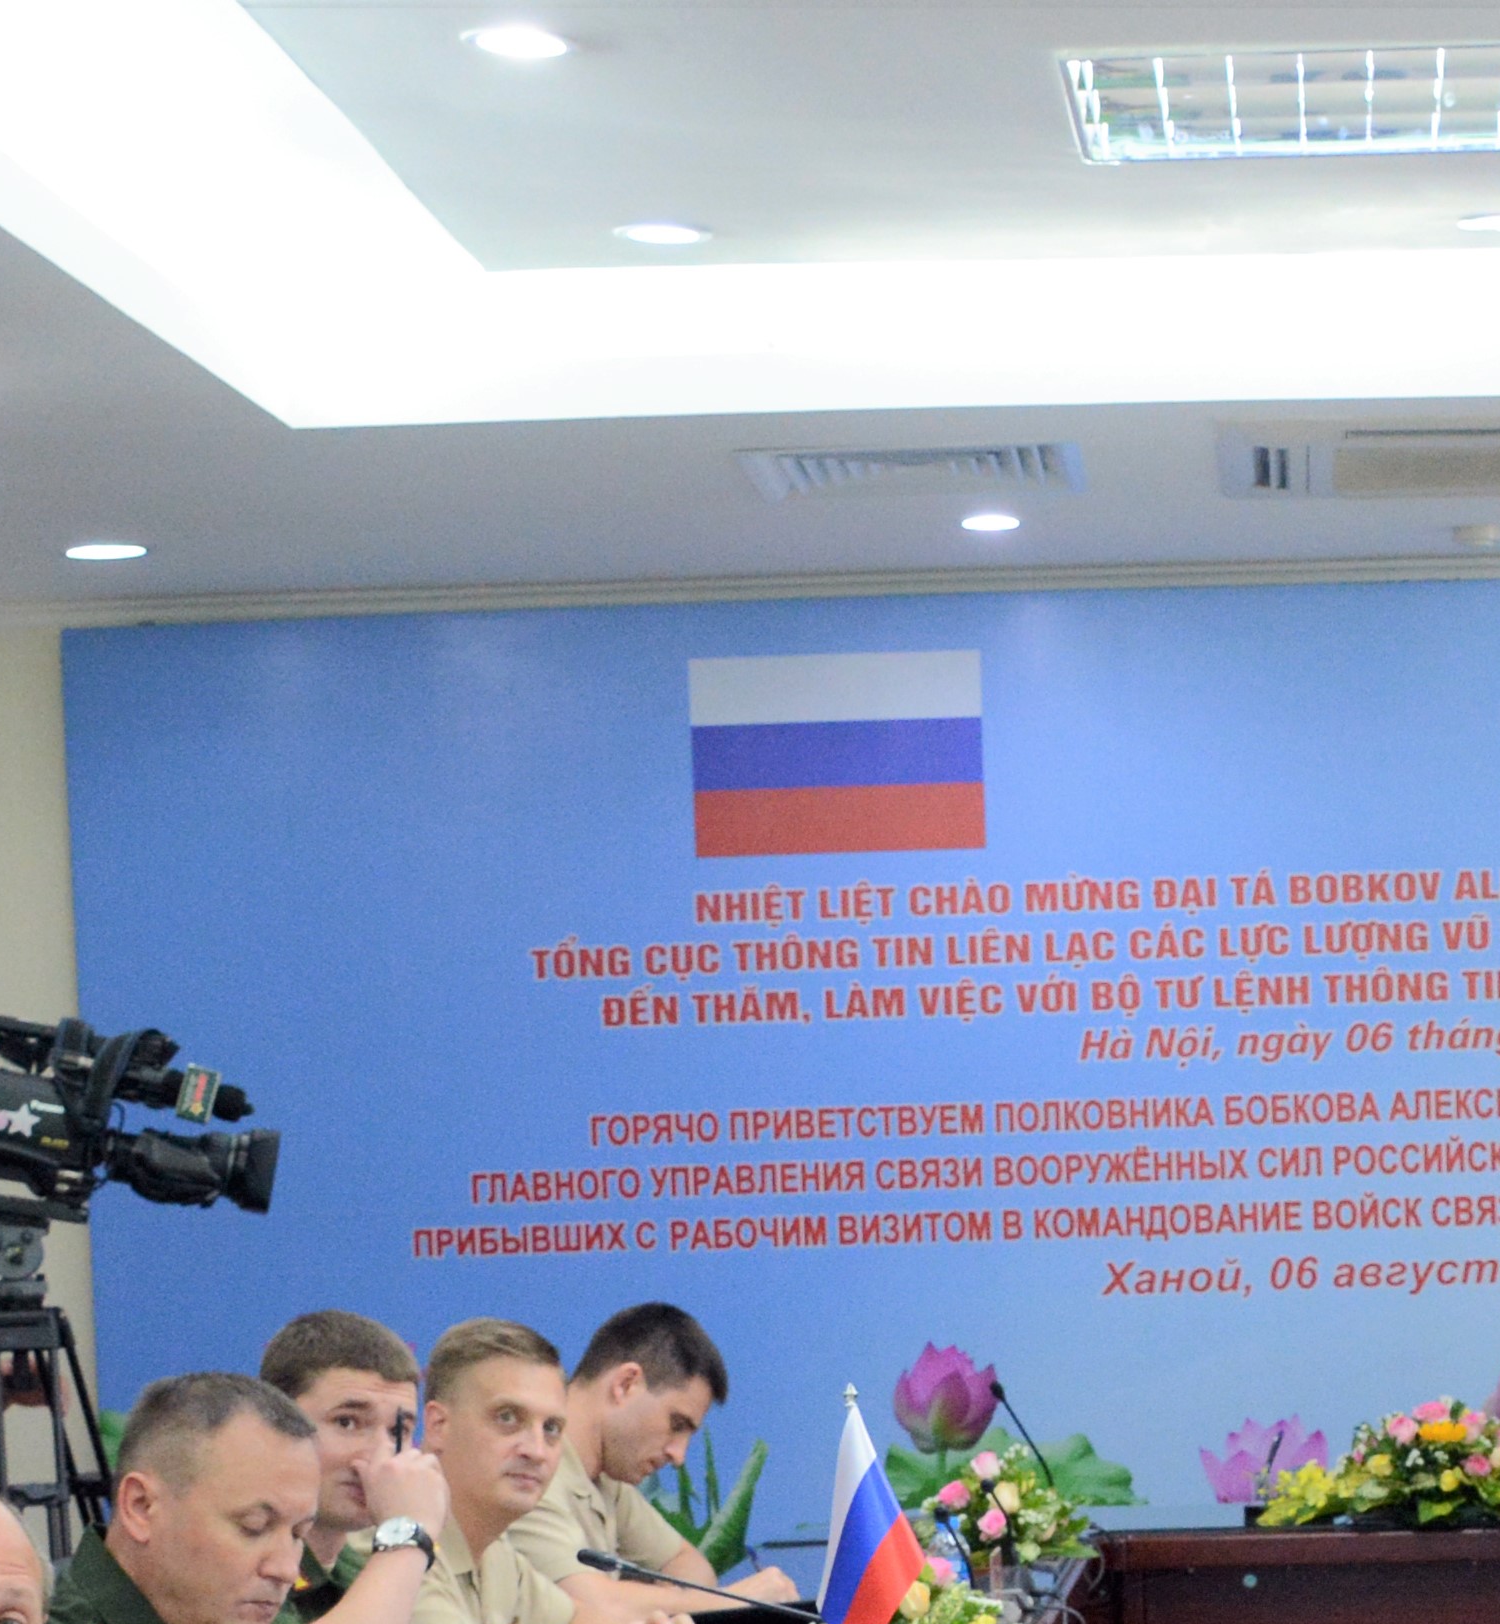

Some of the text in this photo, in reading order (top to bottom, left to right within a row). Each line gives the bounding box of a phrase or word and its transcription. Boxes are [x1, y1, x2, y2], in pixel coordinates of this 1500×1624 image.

[696, 886, 805, 923] NHIỆT
[819, 883, 893, 922] LIỆT
[910, 881, 1011, 916] CHÀO
[1025, 875, 1140, 912] MỪNG
[1154, 875, 1216, 914] ĐẠI
[1232, 868, 1275, 906] TÁ
[1290, 872, 1440, 905] BOBKOV
[533, 939, 630, 979] TỔNG
[645, 944, 719, 979] CỤC
[734, 935, 859, 971] THÔNG
[874, 937, 933, 967] TIN
[947, 930, 1030, 965] LIÊN
[1045, 931, 1115, 968] LẠC
[1130, 924, 1204, 959] CÁC
[1220, 924, 1289, 962] LỰC
[1304, 921, 1429, 957] LƯỢNG
[1444, 916, 1490, 950] VŨ
[603, 984, 678, 1027] ĐẾN
[693, 988, 810, 1023] THĂM,
[825, 985, 905, 1019] LÀM
[920, 979, 1003, 1021] VIỆC
[1017, 976, 1076, 1013] VỚI
[1092, 975, 1140, 1015] BỘ
[1156, 976, 1203, 1008] TƯ
[1214, 972, 1310, 1012] LỆNH
[1325, 967, 1449, 1004] THÔNG
[1081, 1030, 1133, 1059] Hà
[1146, 1026, 1221, 1064] Nội,
[1238, 1031, 1331, 1063] ngày
[1347, 1022, 1393, 1052] 06
[591, 1112, 719, 1145] ГОРЯЧО
[730, 1104, 984, 1140] ПРИВЕТСТВУЕМ
[995, 1097, 1214, 1134] ПОЛКОВНИКА
[1225, 1092, 1380, 1126] БОБКОВА
[473, 1168, 641, 1203] ГЛАВНОГО
[651, 1160, 865, 1196] УПРАВЛЕНИЯ
[876, 1157, 983, 1190] СВЯЗИ
[994, 1146, 1247, 1187] ВООРУЖЁННЫХ
[1258, 1147, 1323, 1179] СИЛ
[414, 1223, 625, 1256] ПРИБЫВШИХ
[636, 1222, 655, 1249] С
[671, 1216, 827, 1249] РАБОЧИМ
[839, 1211, 991, 1245] ВИЗИТОМ
[1003, 1210, 1023, 1240] В
[1034, 1201, 1302, 1240] КОМАНДОВАНИЕ
[1313, 1193, 1422, 1230] ВОЙСК
[1104, 1258, 1253, 1300] Ханой,
[1270, 1256, 1318, 1290] 06
